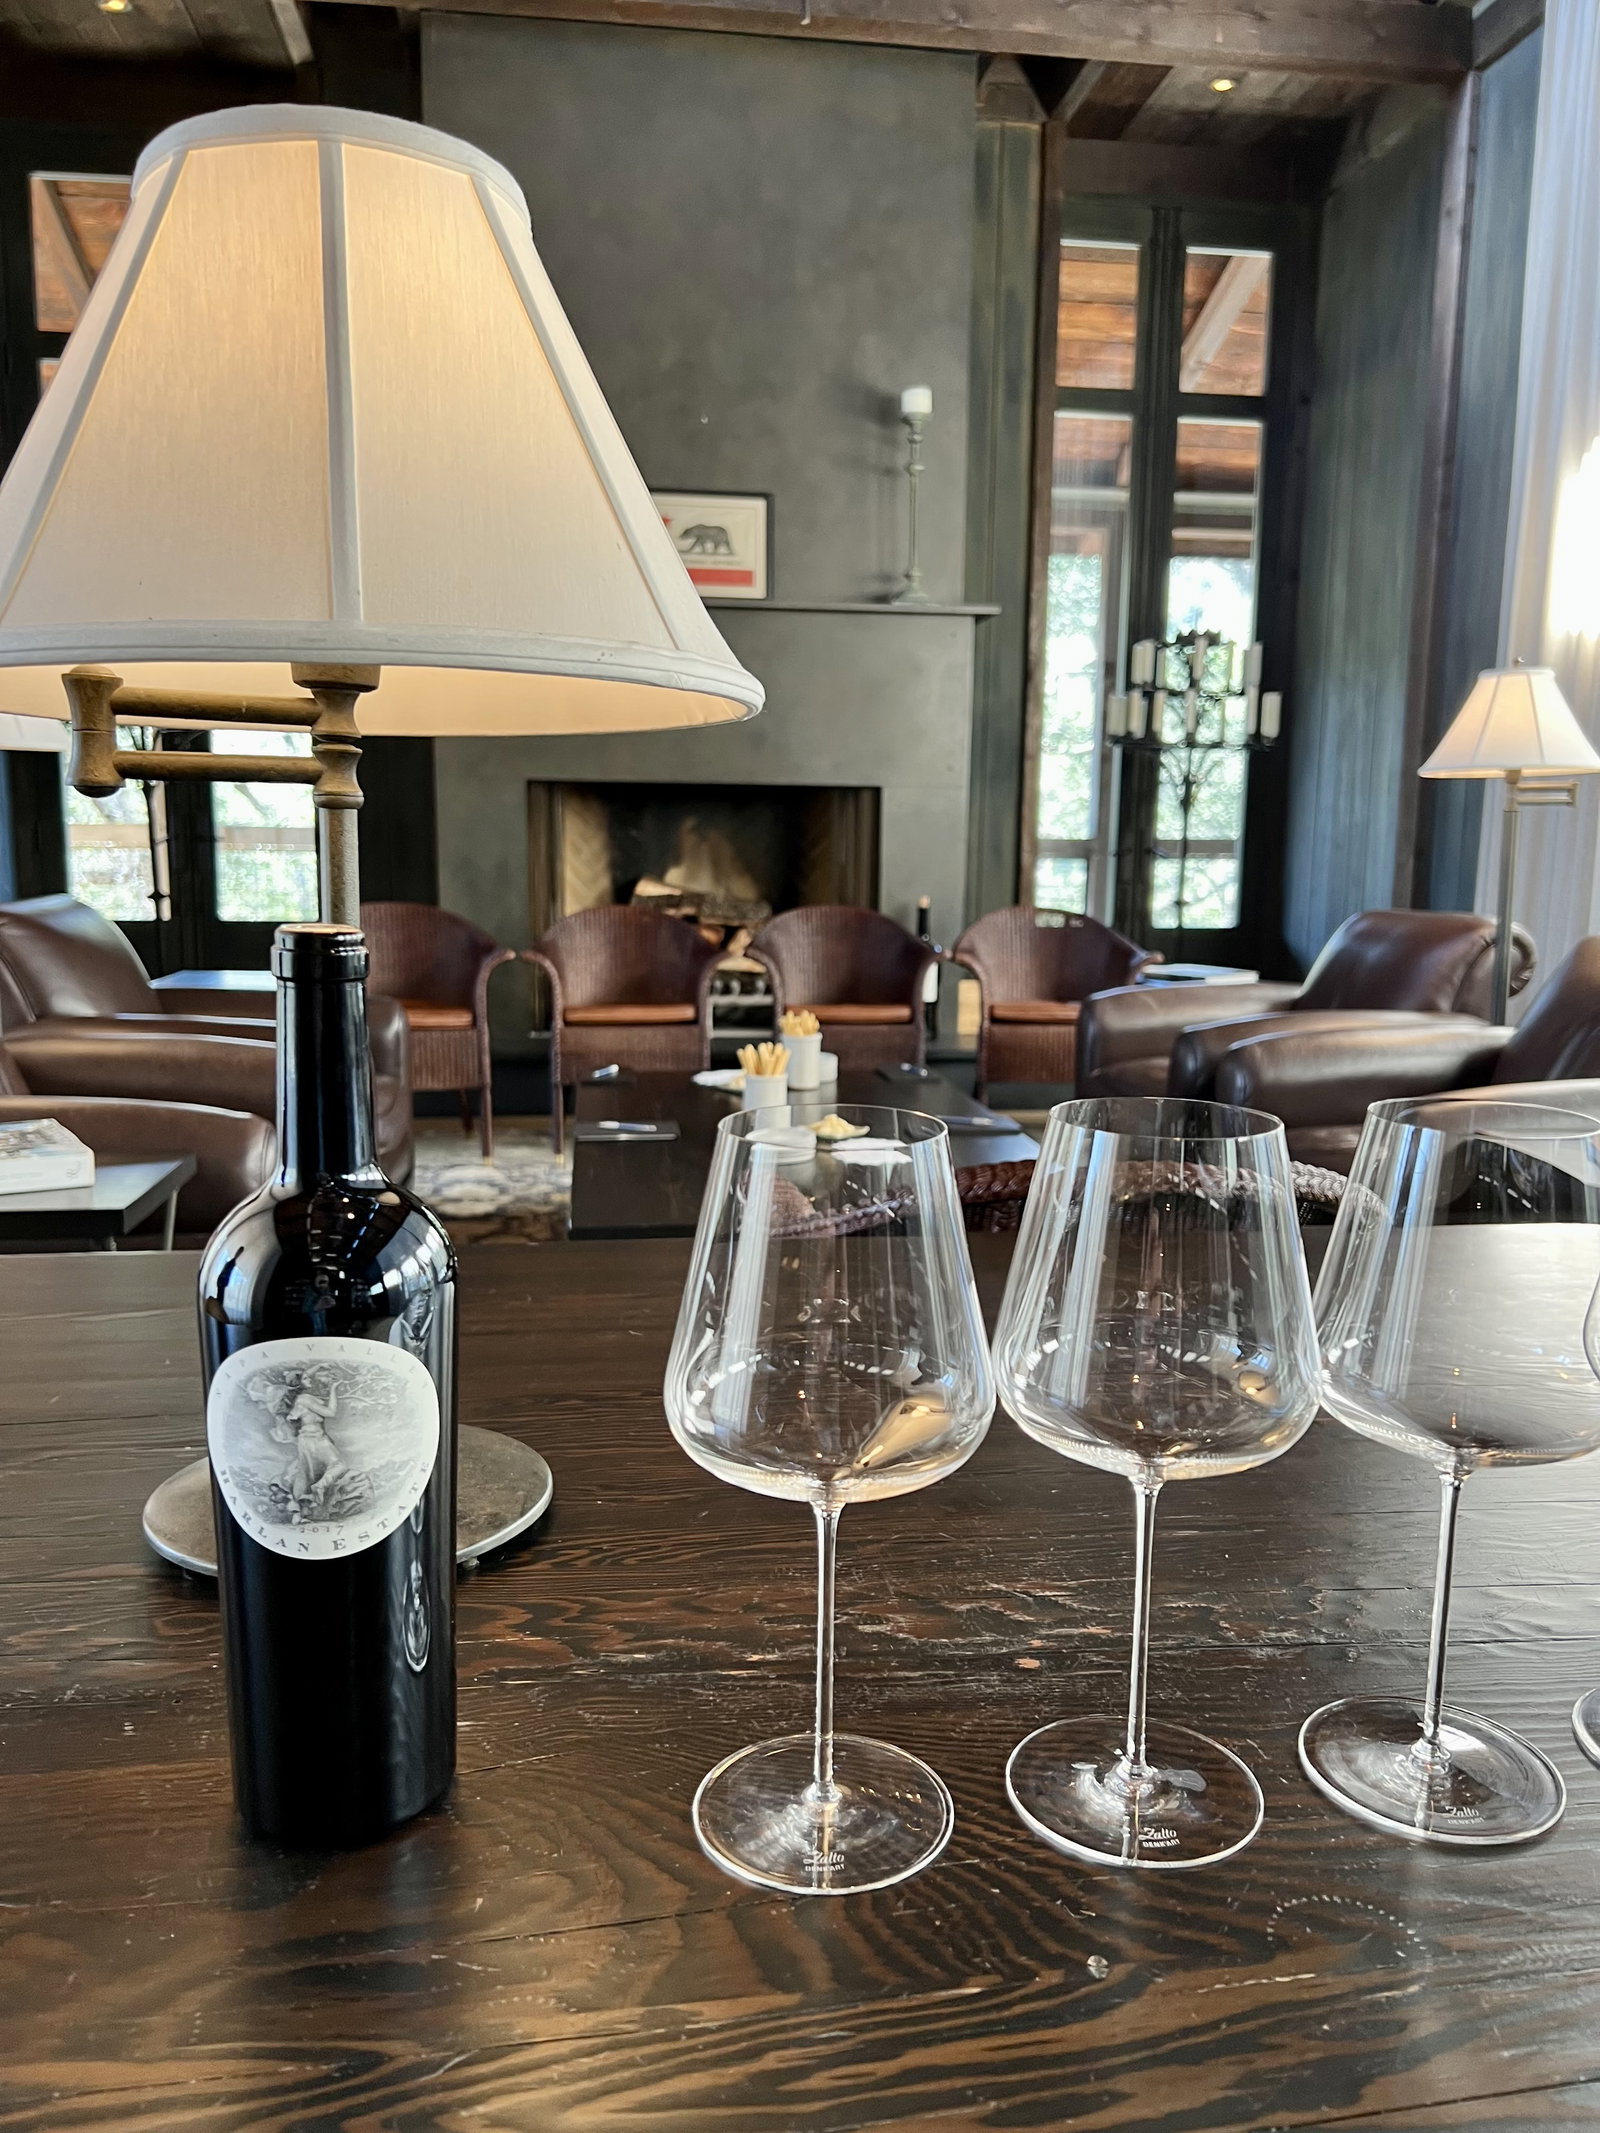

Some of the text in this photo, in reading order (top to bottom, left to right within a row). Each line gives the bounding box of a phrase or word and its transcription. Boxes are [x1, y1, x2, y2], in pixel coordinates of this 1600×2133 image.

[306, 1343, 429, 1390] VALLEY
[220, 1462, 430, 1552] HARLAN ESTATE
[298, 1524, 344, 1535] 2017
[1138, 1827, 1177, 1840] Zalto
